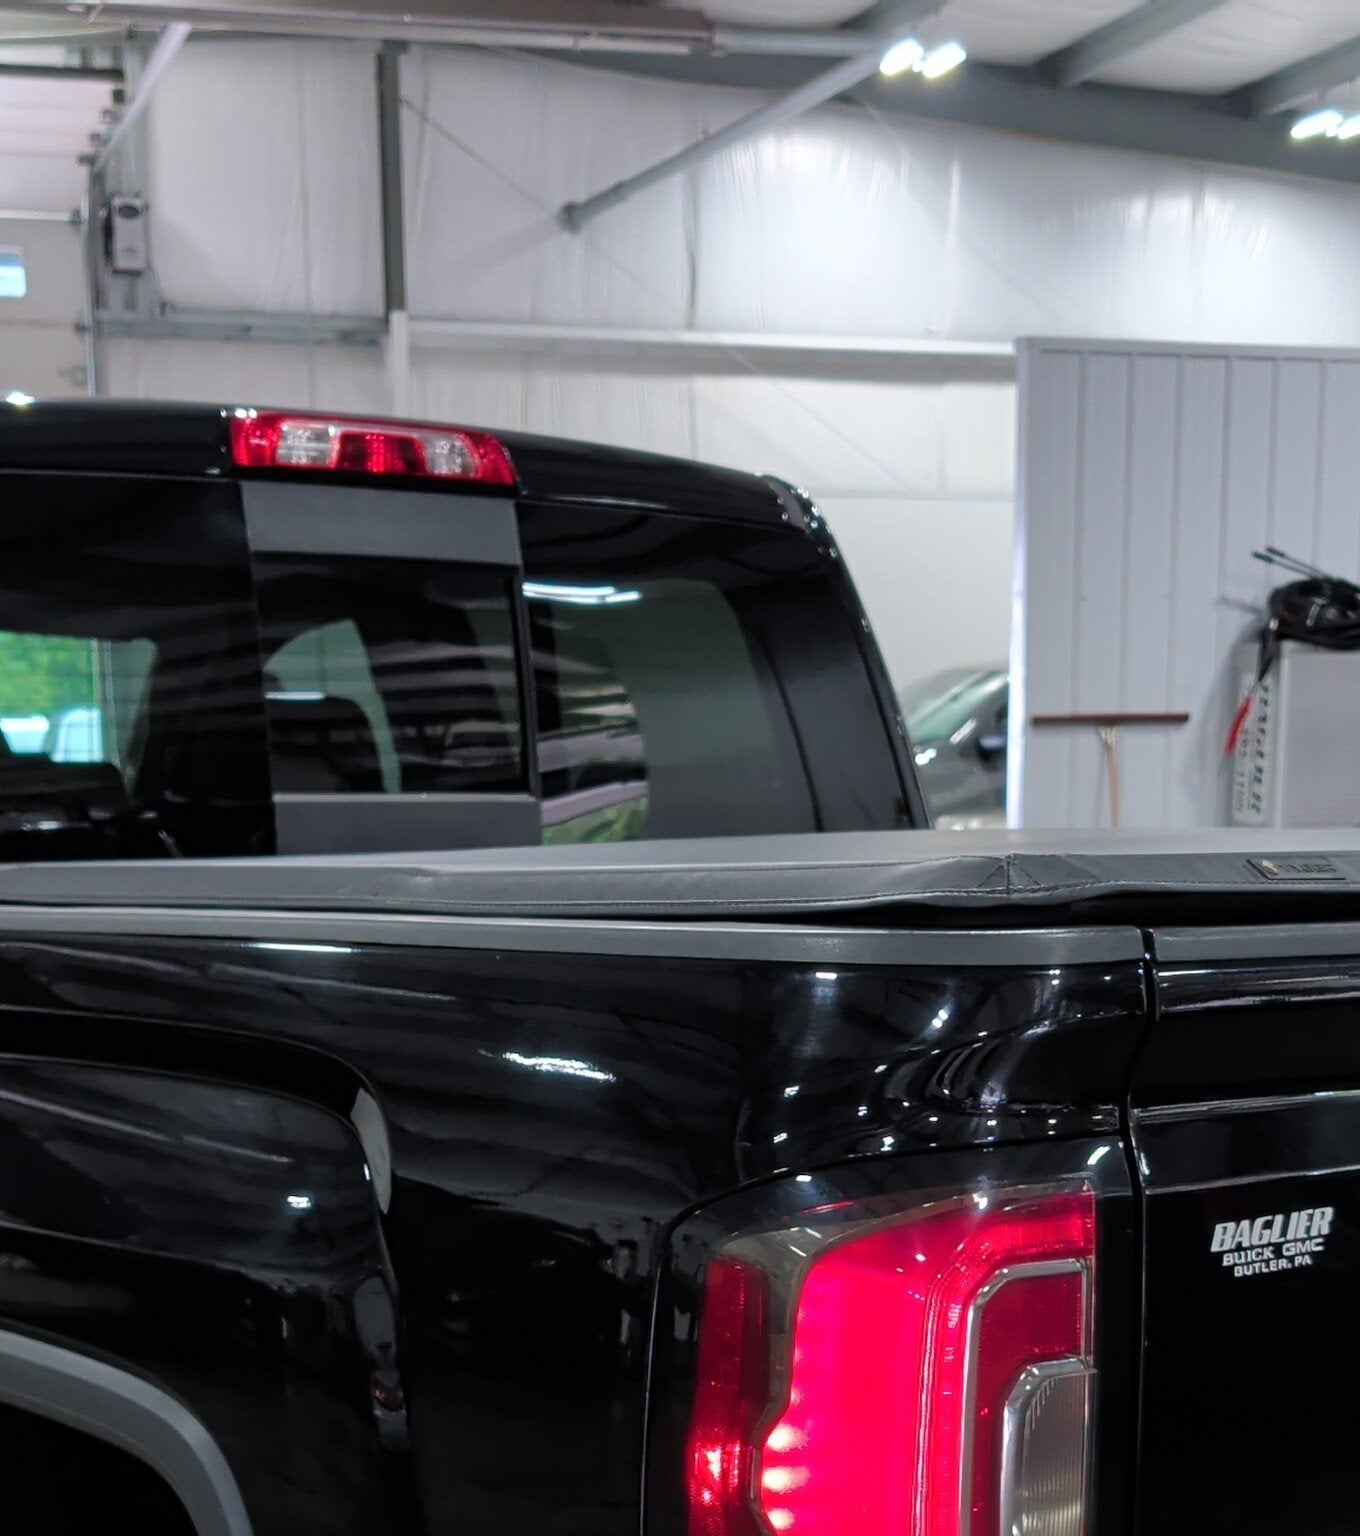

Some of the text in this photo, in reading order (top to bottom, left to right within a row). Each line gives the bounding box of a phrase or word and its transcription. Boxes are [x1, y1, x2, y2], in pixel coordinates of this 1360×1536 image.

[1210, 1206, 1334, 1252] BAGLIER
[1222, 1237, 1325, 1267] BUICK GMC
[1294, 1254, 1312, 1267] PA
